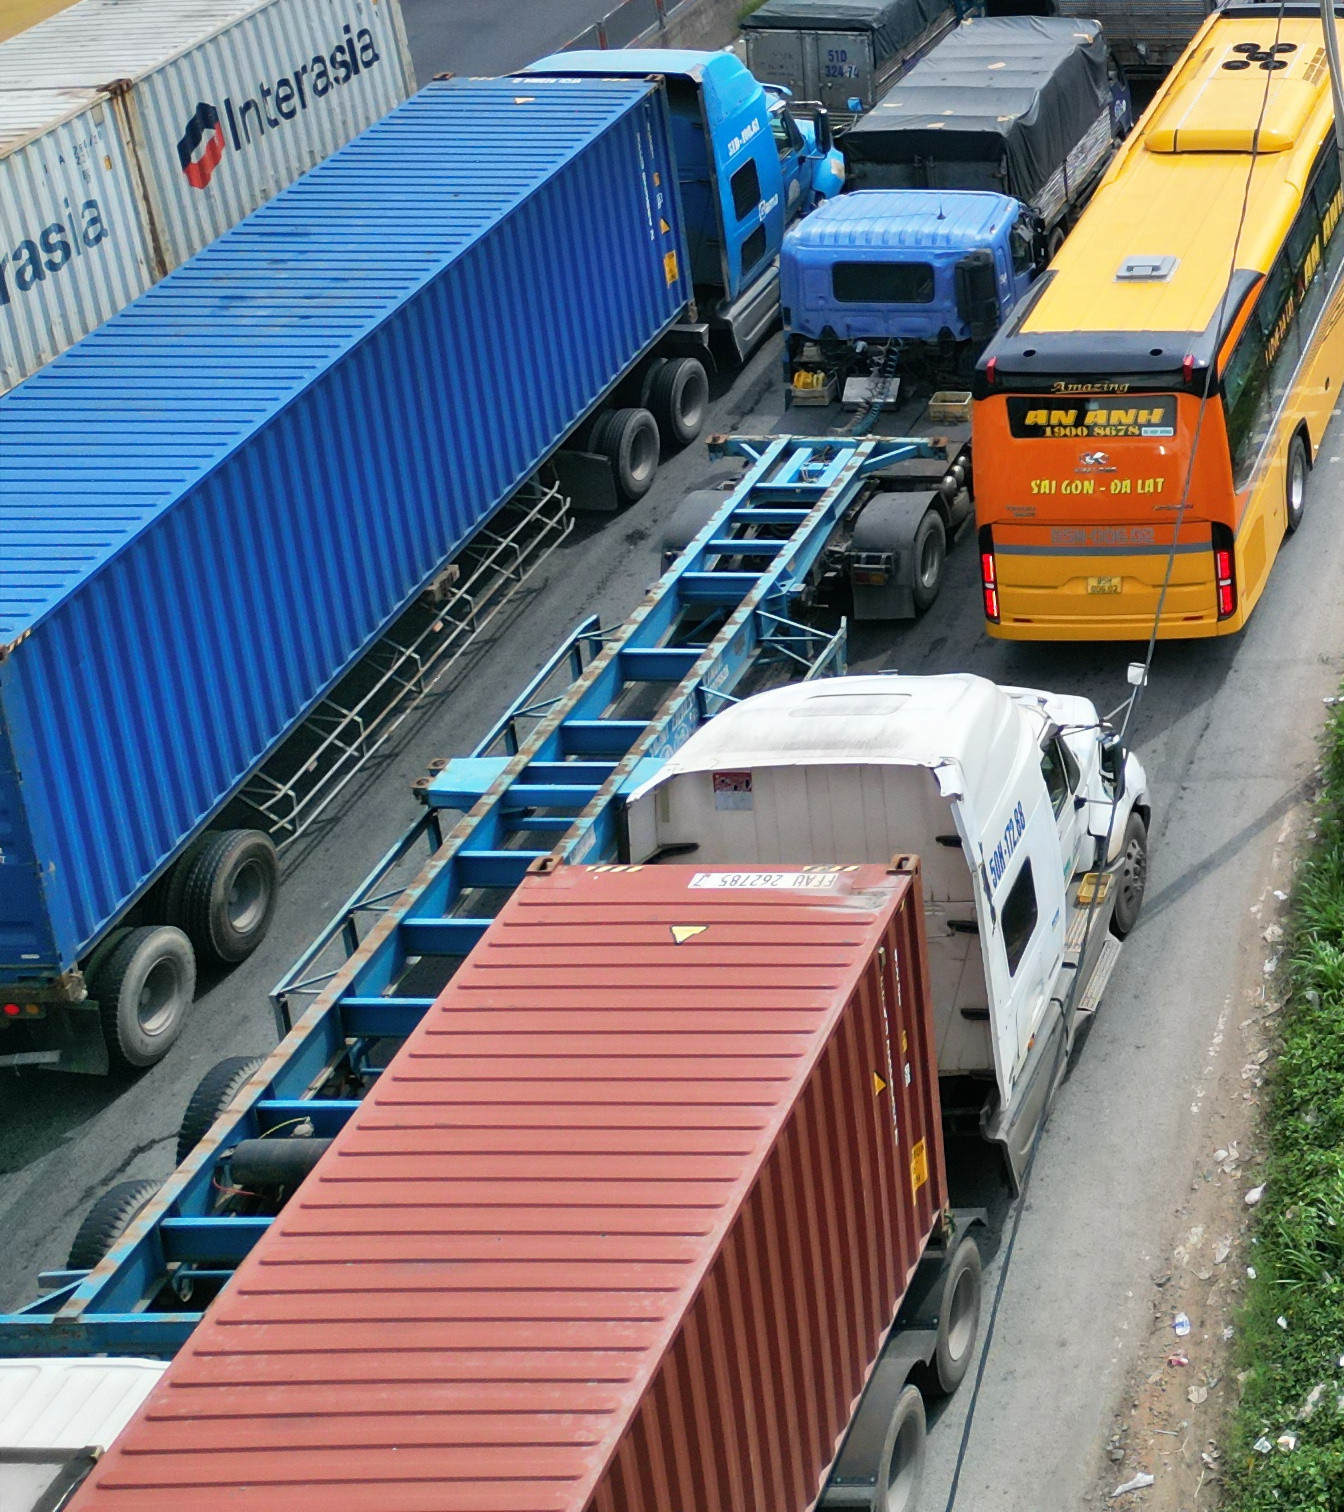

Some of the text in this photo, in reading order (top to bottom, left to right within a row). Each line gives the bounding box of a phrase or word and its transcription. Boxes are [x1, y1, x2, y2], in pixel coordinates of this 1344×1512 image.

[224, 24, 381, 151] Interasia
[1051, 381, 1130, 394] Amazing
[1024, 408, 1166, 426] AN ANH
[1043, 425, 1140, 437] 1900 8678
